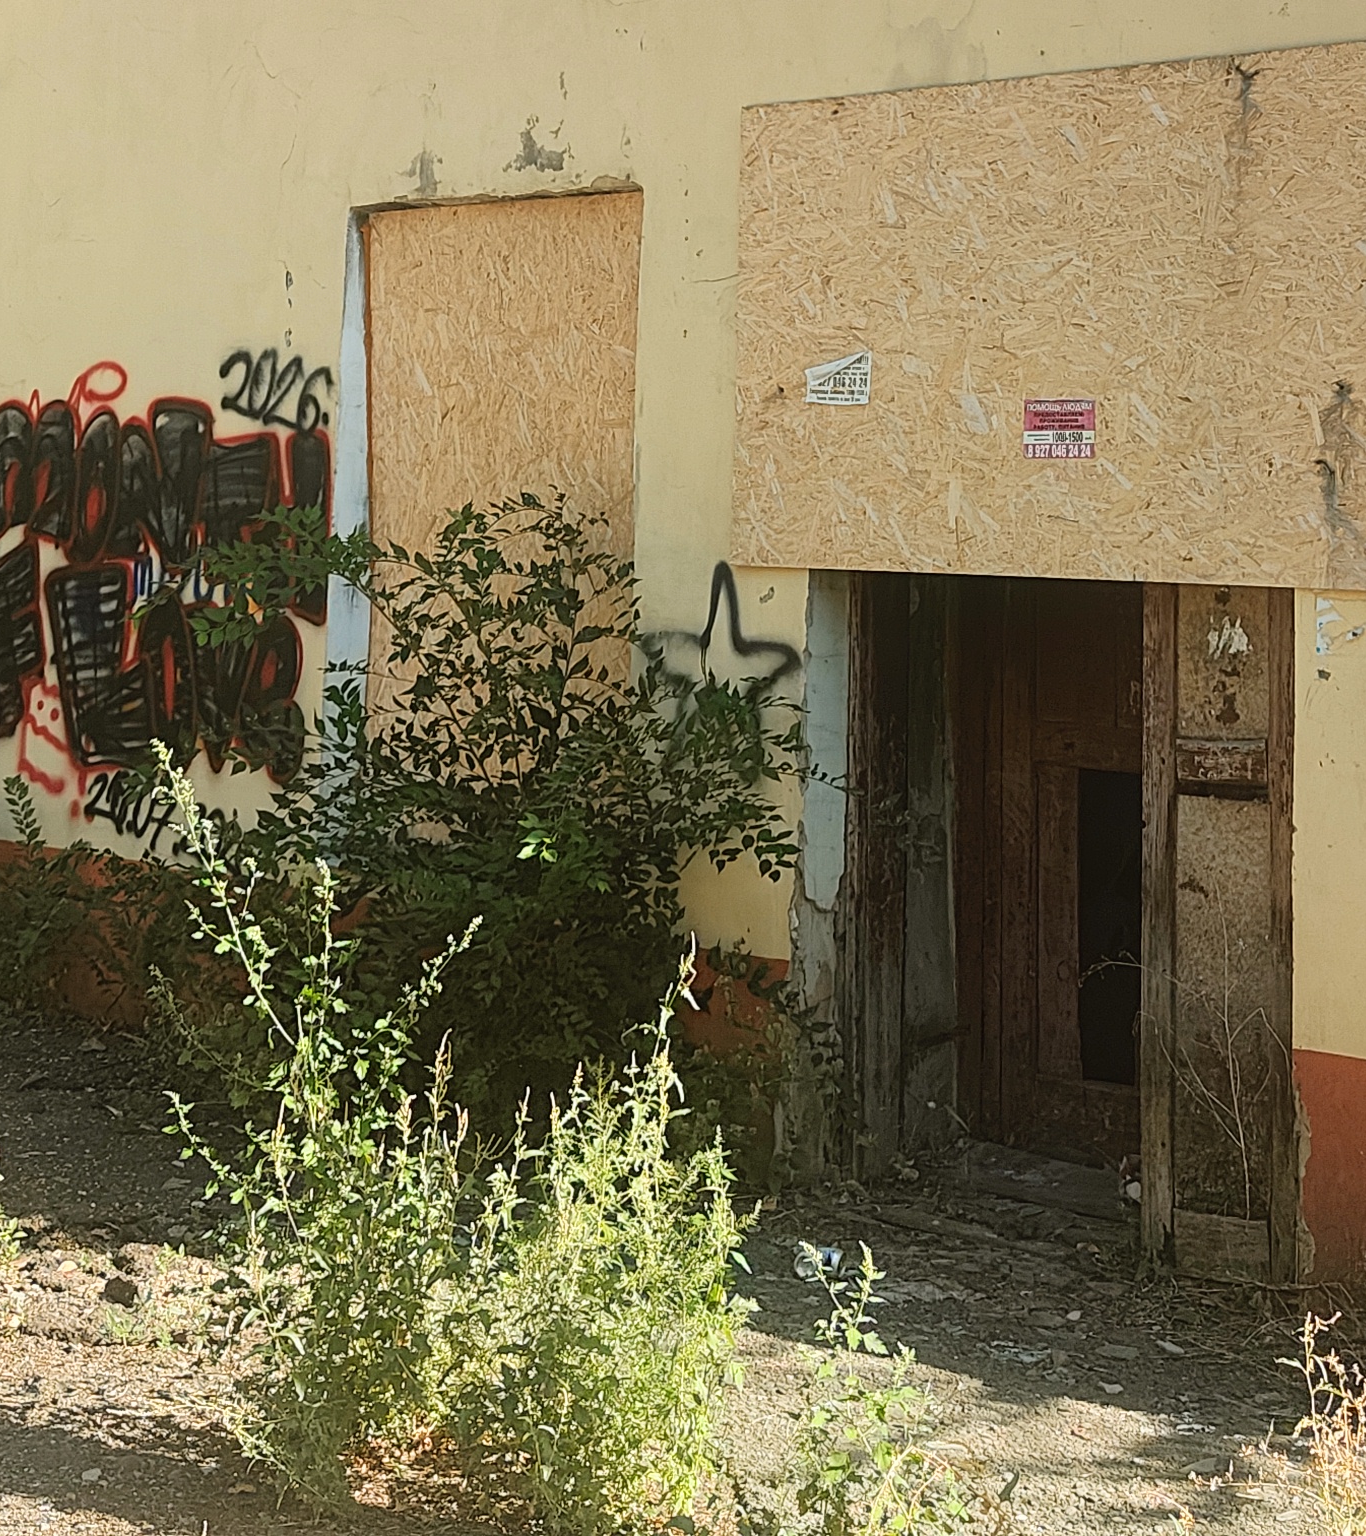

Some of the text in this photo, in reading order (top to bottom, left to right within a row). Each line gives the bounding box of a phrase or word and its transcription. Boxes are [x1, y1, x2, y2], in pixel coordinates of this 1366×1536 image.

[1027, 445, 1091, 457] 8 927 046 24 24
